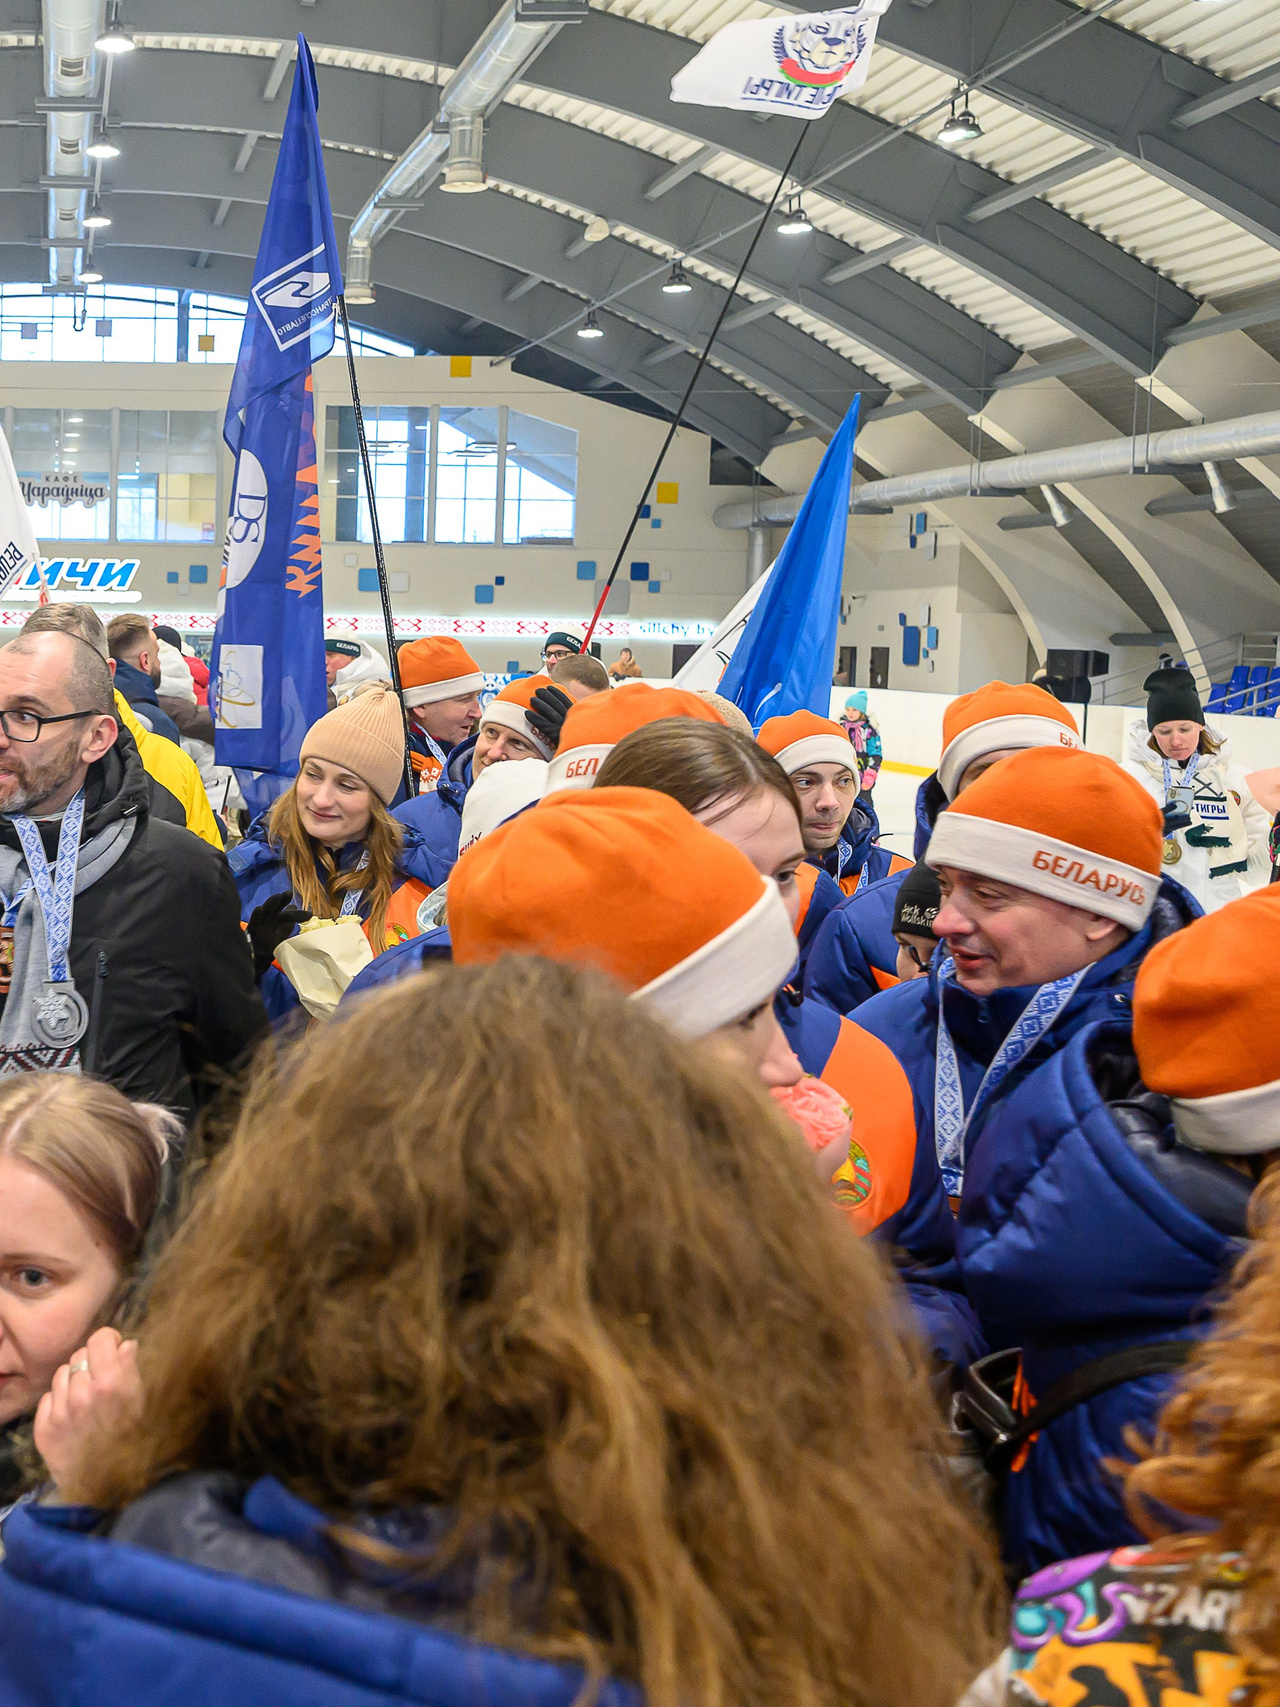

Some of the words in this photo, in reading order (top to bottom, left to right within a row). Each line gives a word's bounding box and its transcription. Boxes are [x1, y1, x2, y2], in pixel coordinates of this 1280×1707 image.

[45, 475, 78, 484] КАФЕ
[1195, 803, 1226, 814] ТИГРЫ
[1031, 850, 1146, 906] БЕЛАРУСЬ
